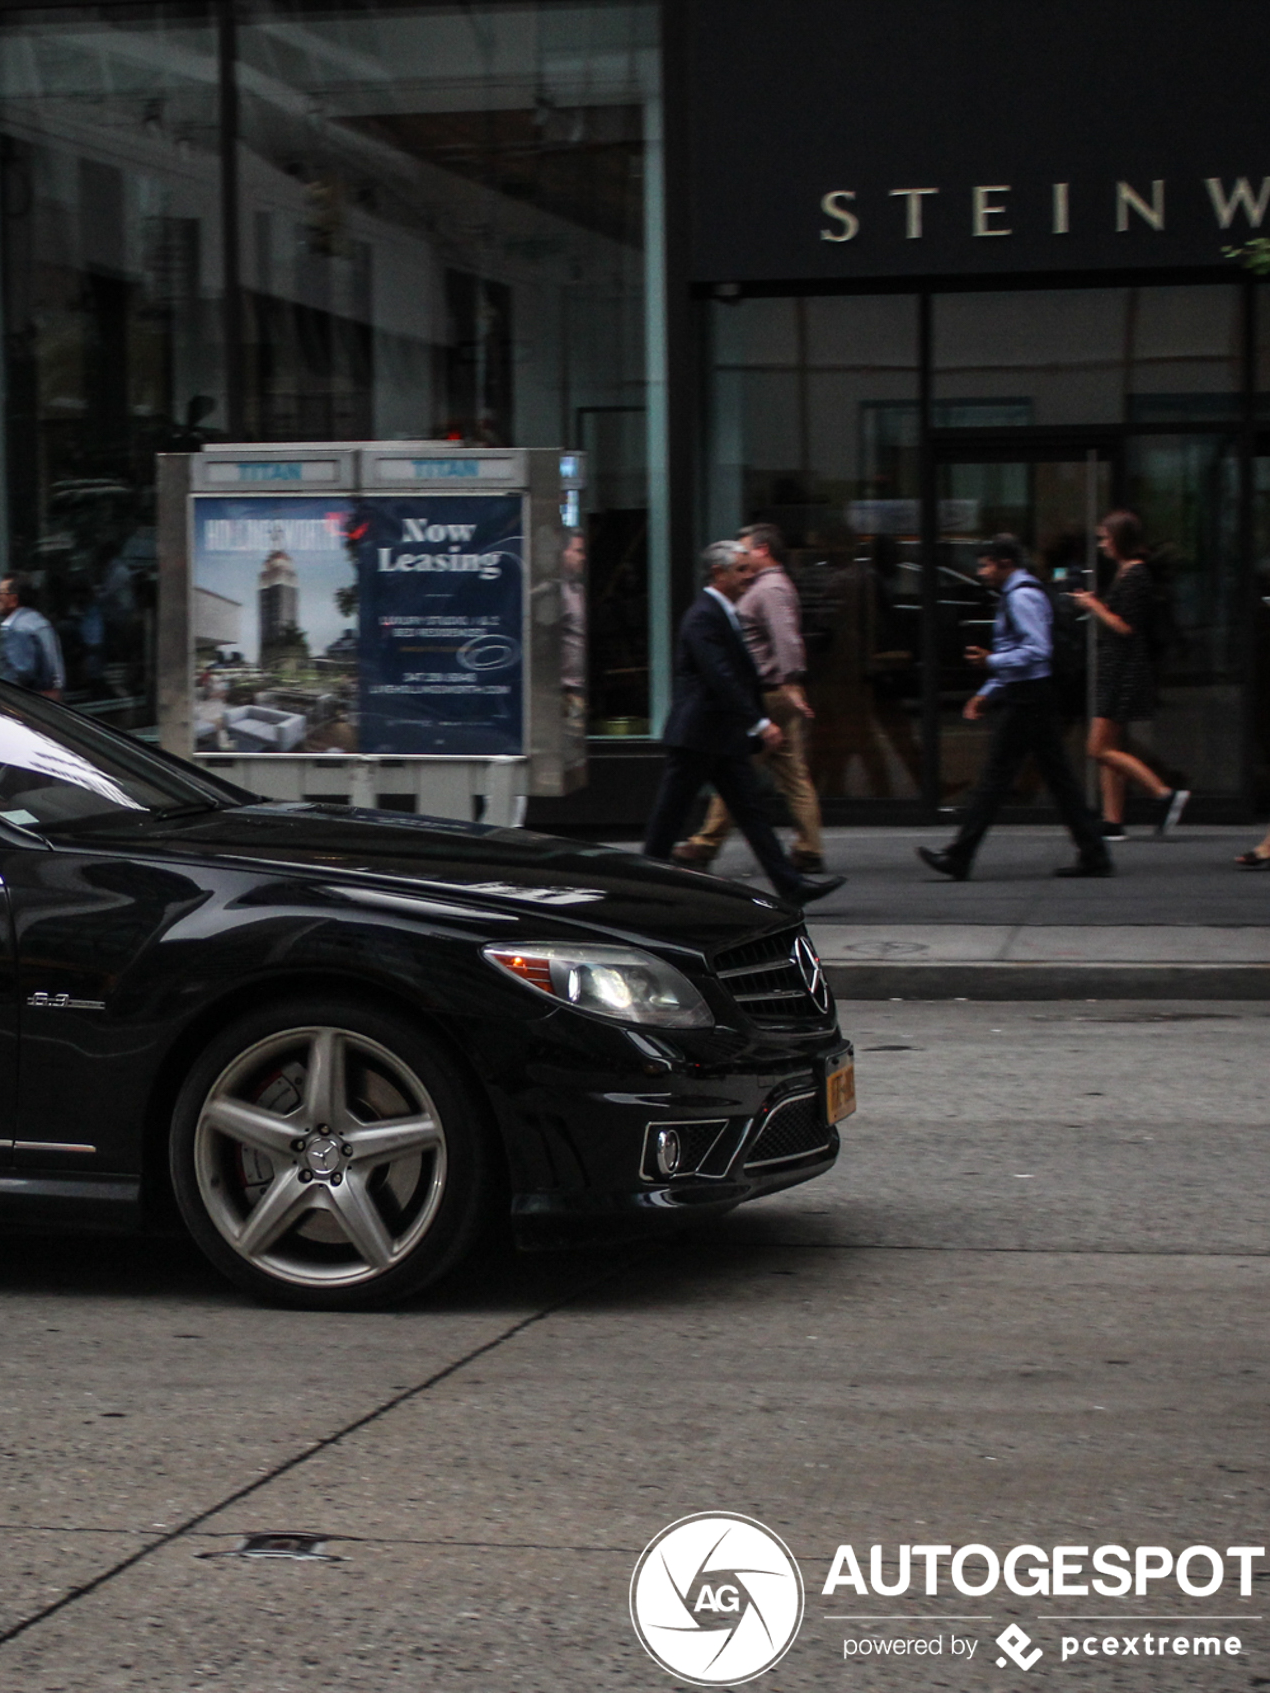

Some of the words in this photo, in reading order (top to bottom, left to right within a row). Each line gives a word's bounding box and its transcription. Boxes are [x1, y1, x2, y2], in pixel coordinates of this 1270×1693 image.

[820, 177, 1270, 244] STEINW
[237, 463, 303, 481] TITAN
[411, 460, 480, 478] TITAN
[401, 518, 477, 543] Now
[376, 545, 503, 581] Leasing
[33, 992, 69, 1007] 6.3
